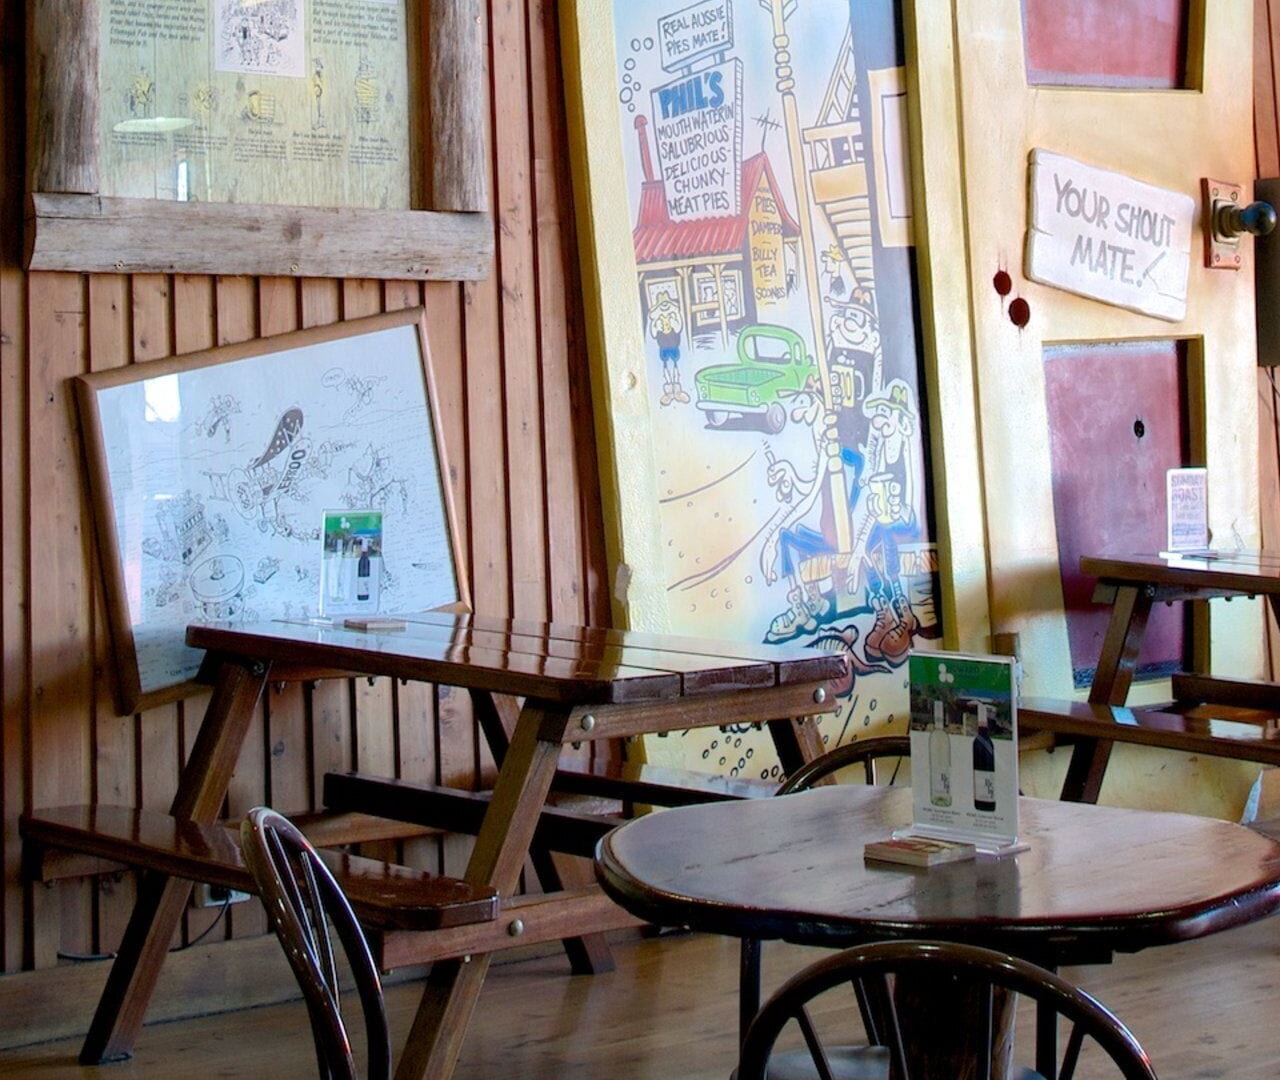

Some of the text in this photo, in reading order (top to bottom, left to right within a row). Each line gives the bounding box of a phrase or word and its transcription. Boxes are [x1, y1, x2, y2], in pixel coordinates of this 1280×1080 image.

[662, 5, 725, 40] REAL AUSSIE
[666, 22, 726, 58] PIES MATE!
[657, 70, 725, 120] PHIL'S
[668, 190, 730, 218] MEAT PIES
[755, 195, 777, 215] PIES
[1053, 173, 1177, 248] YOUR SHOUT
[752, 246, 778, 261] BILLY
[755, 264, 777, 278] TEA
[1070, 234, 1167, 288] MATE!
